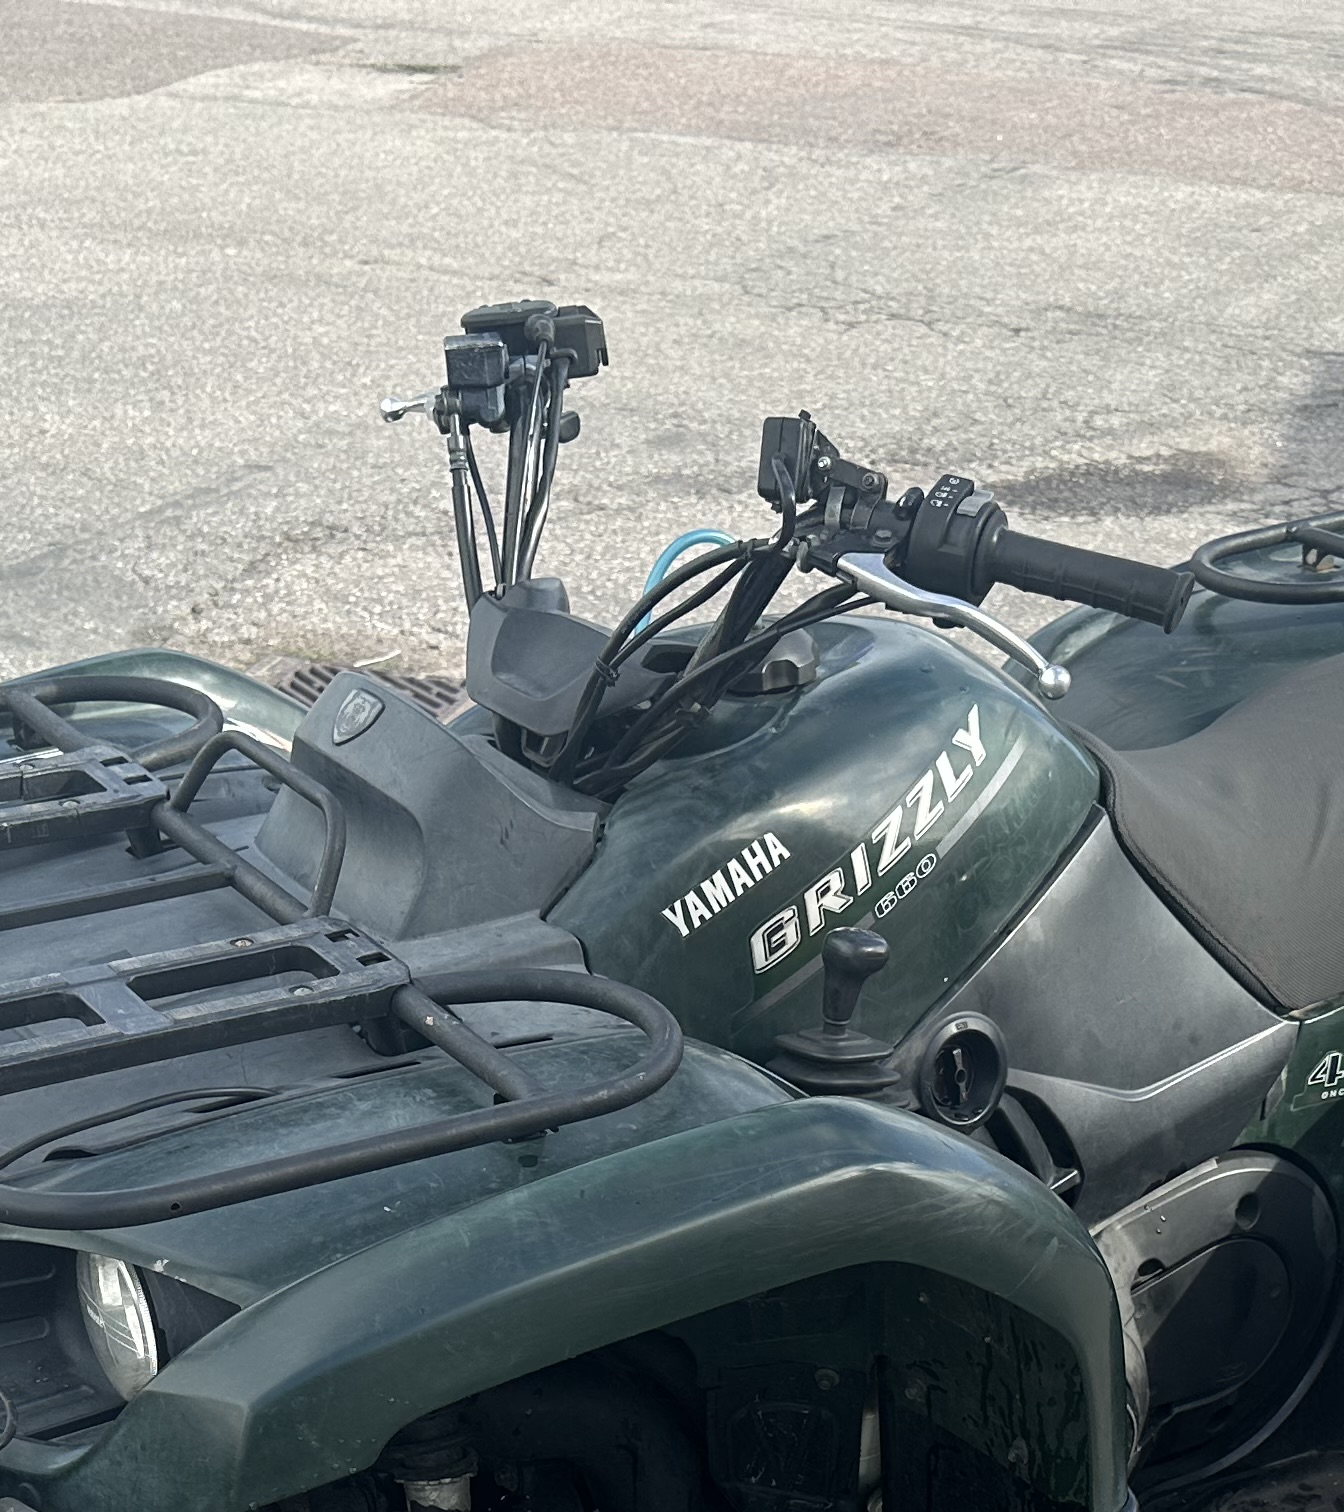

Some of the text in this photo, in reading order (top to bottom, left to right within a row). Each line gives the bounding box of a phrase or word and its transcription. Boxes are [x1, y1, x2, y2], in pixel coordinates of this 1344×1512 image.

[661, 832, 791, 938] YAMAHA
[749, 703, 987, 975] GRIZZLY
[874, 852, 937, 919] 660
